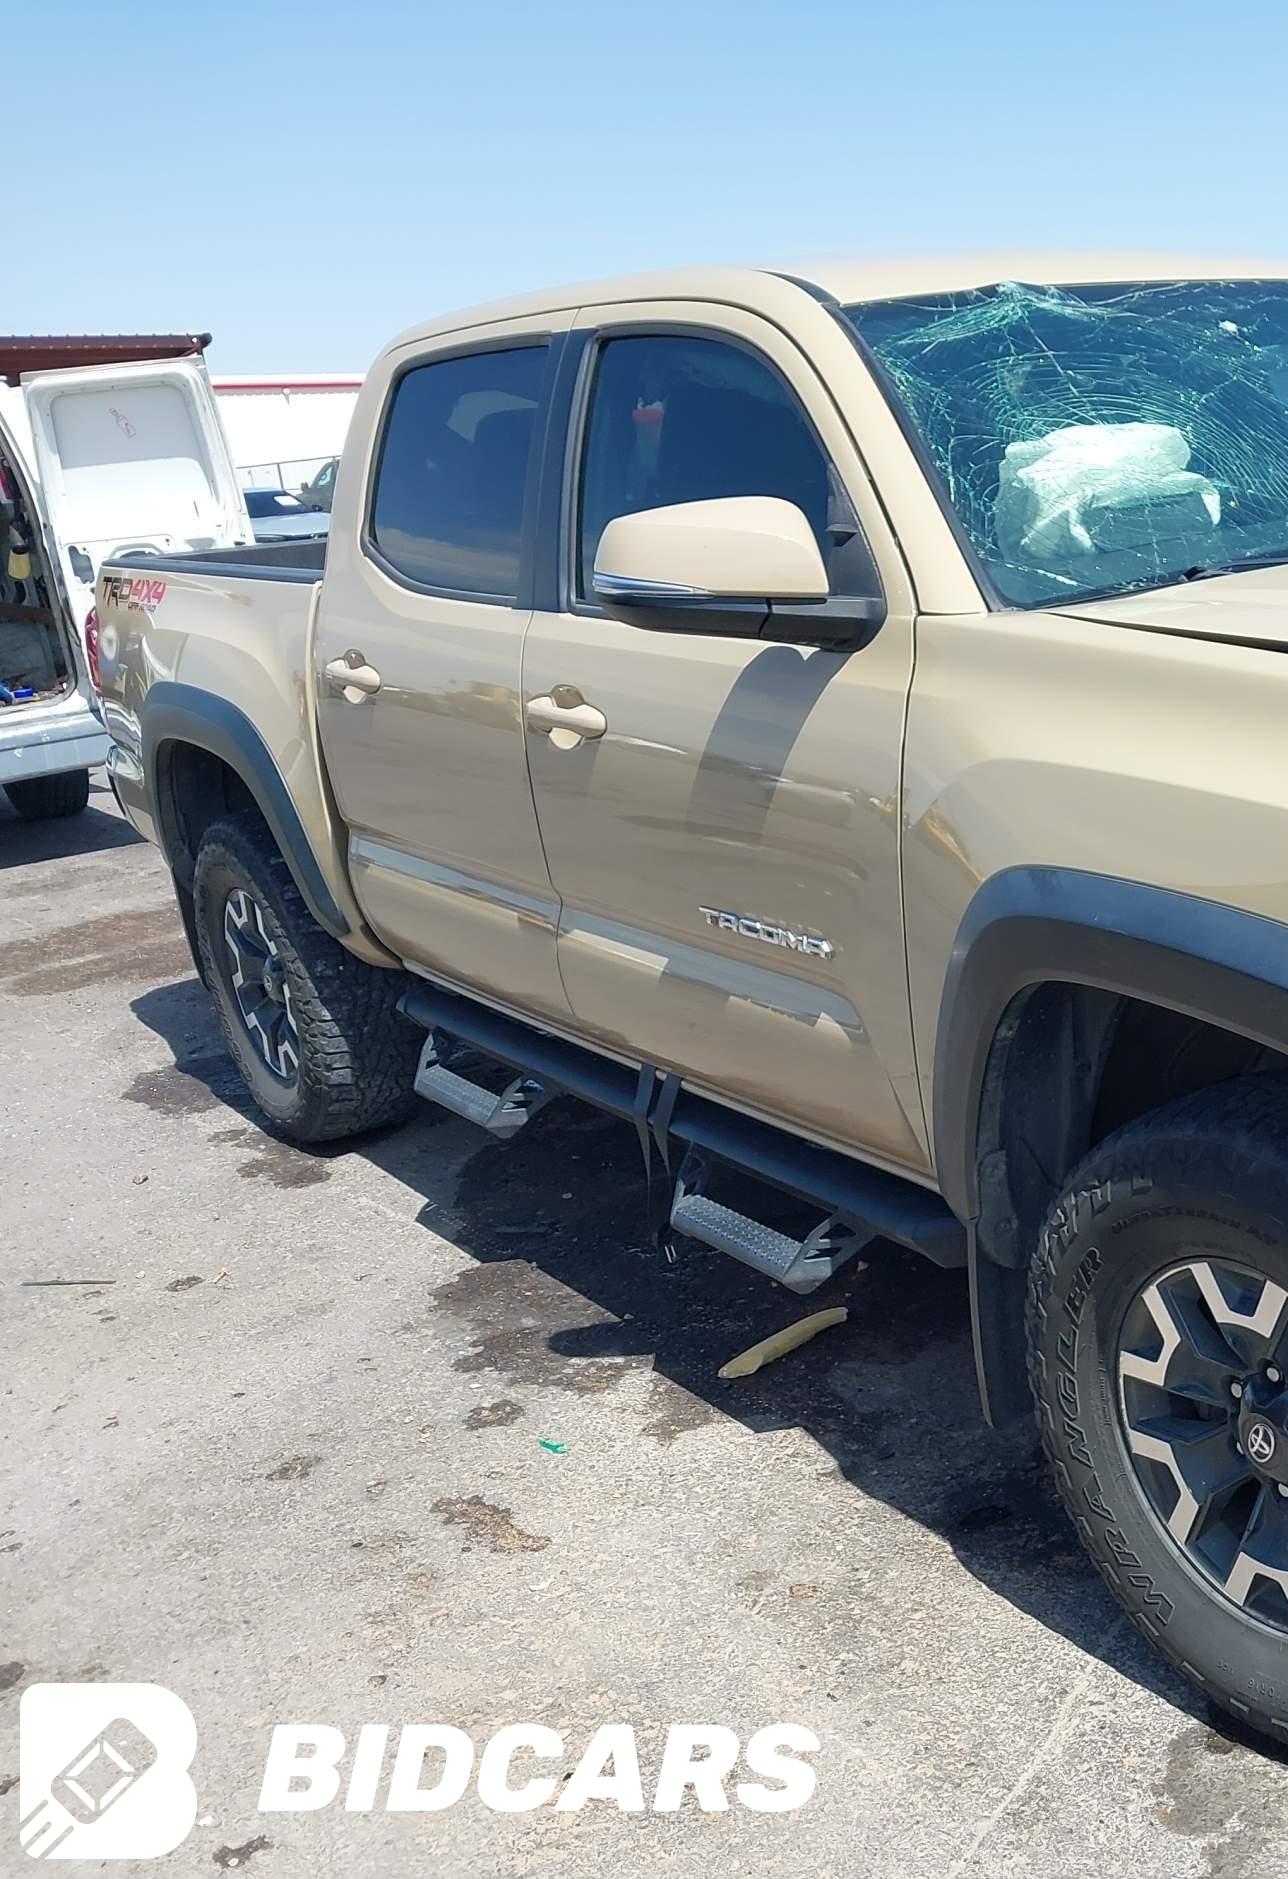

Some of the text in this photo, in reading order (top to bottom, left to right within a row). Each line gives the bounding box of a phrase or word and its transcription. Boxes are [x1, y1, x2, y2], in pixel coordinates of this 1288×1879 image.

[103, 576, 132, 608] TRD
[698, 905, 834, 960] TACOMA
[1057, 1245, 1176, 1631] WRANGLER
